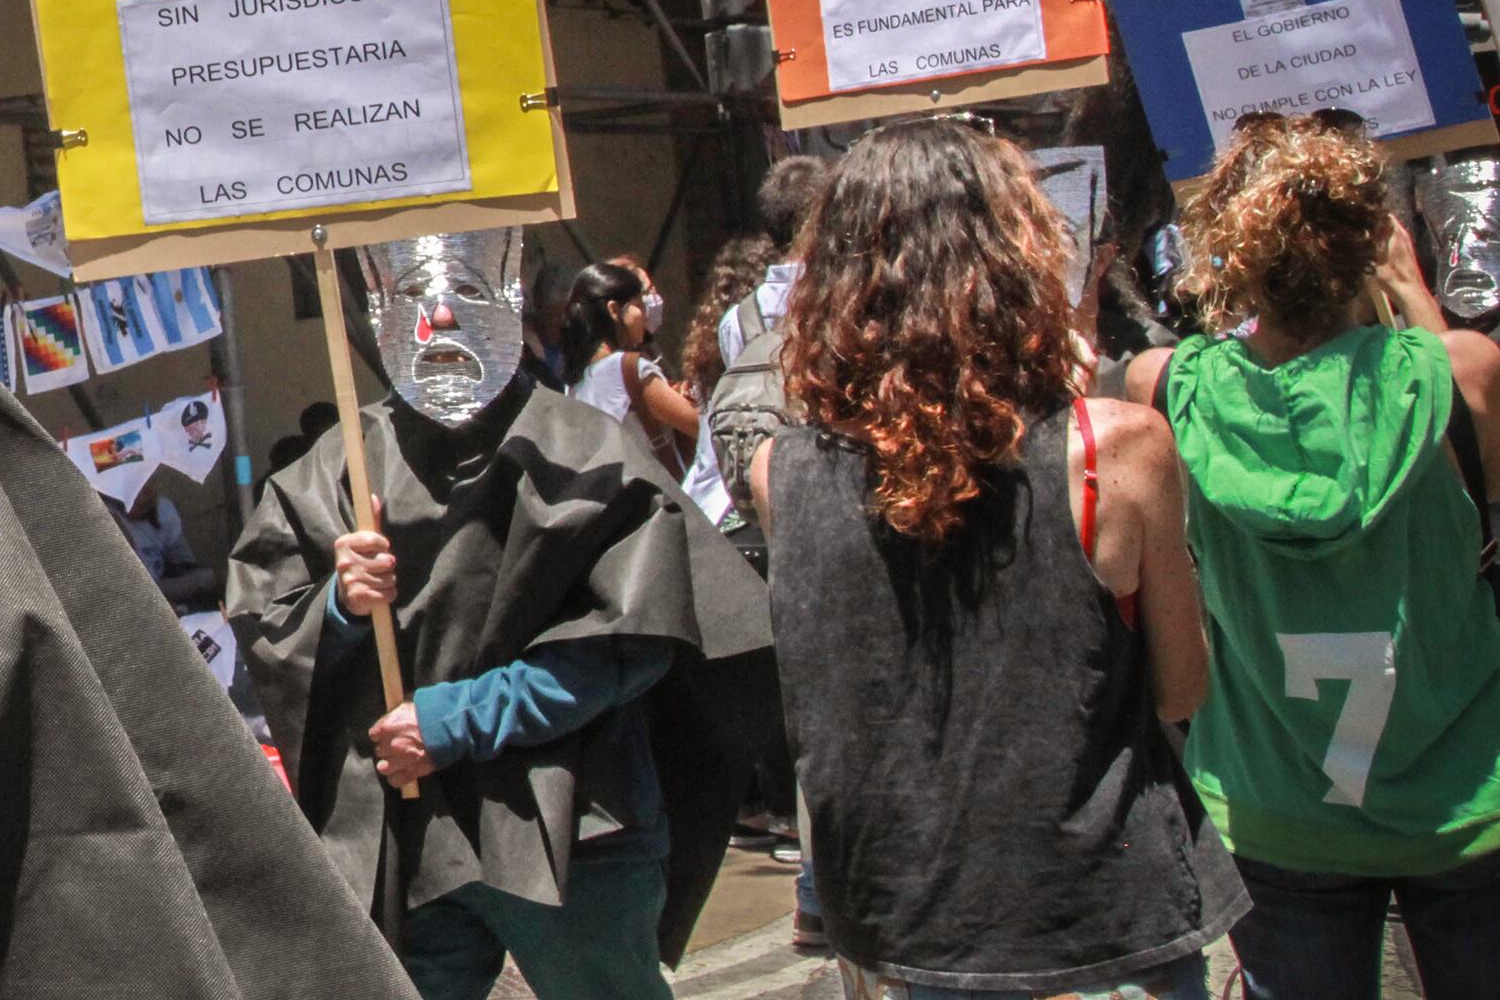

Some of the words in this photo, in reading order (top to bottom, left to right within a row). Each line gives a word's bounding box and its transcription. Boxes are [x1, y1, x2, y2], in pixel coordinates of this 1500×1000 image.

[158, 4, 200, 27] SIN
[833, 23, 854, 39] ES
[858, 1, 978, 34] FUNDAMENTAL
[1232, 29, 1254, 44] EL
[1257, 6, 1350, 37] GOBIERNO
[172, 39, 406, 86] PRESUPUESTARIA
[869, 60, 899, 78] LAS
[916, 43, 1001, 71] COMUNAS
[1238, 65, 1260, 80] DE
[1265, 59, 1287, 75] LA
[1290, 44, 1357, 68] CIUDAD
[1212, 107, 1238, 122] NO
[1314, 84, 1354, 102] CON
[1357, 77, 1381, 94] LA
[1384, 69, 1418, 88] LEY
[165, 126, 202, 147] NO
[231, 118, 265, 140] SE
[294, 99, 421, 132] REALIZAN
[200, 181, 247, 204] LAS
[276, 162, 409, 195] COMUNAS
[1275, 630, 1396, 809] 7
